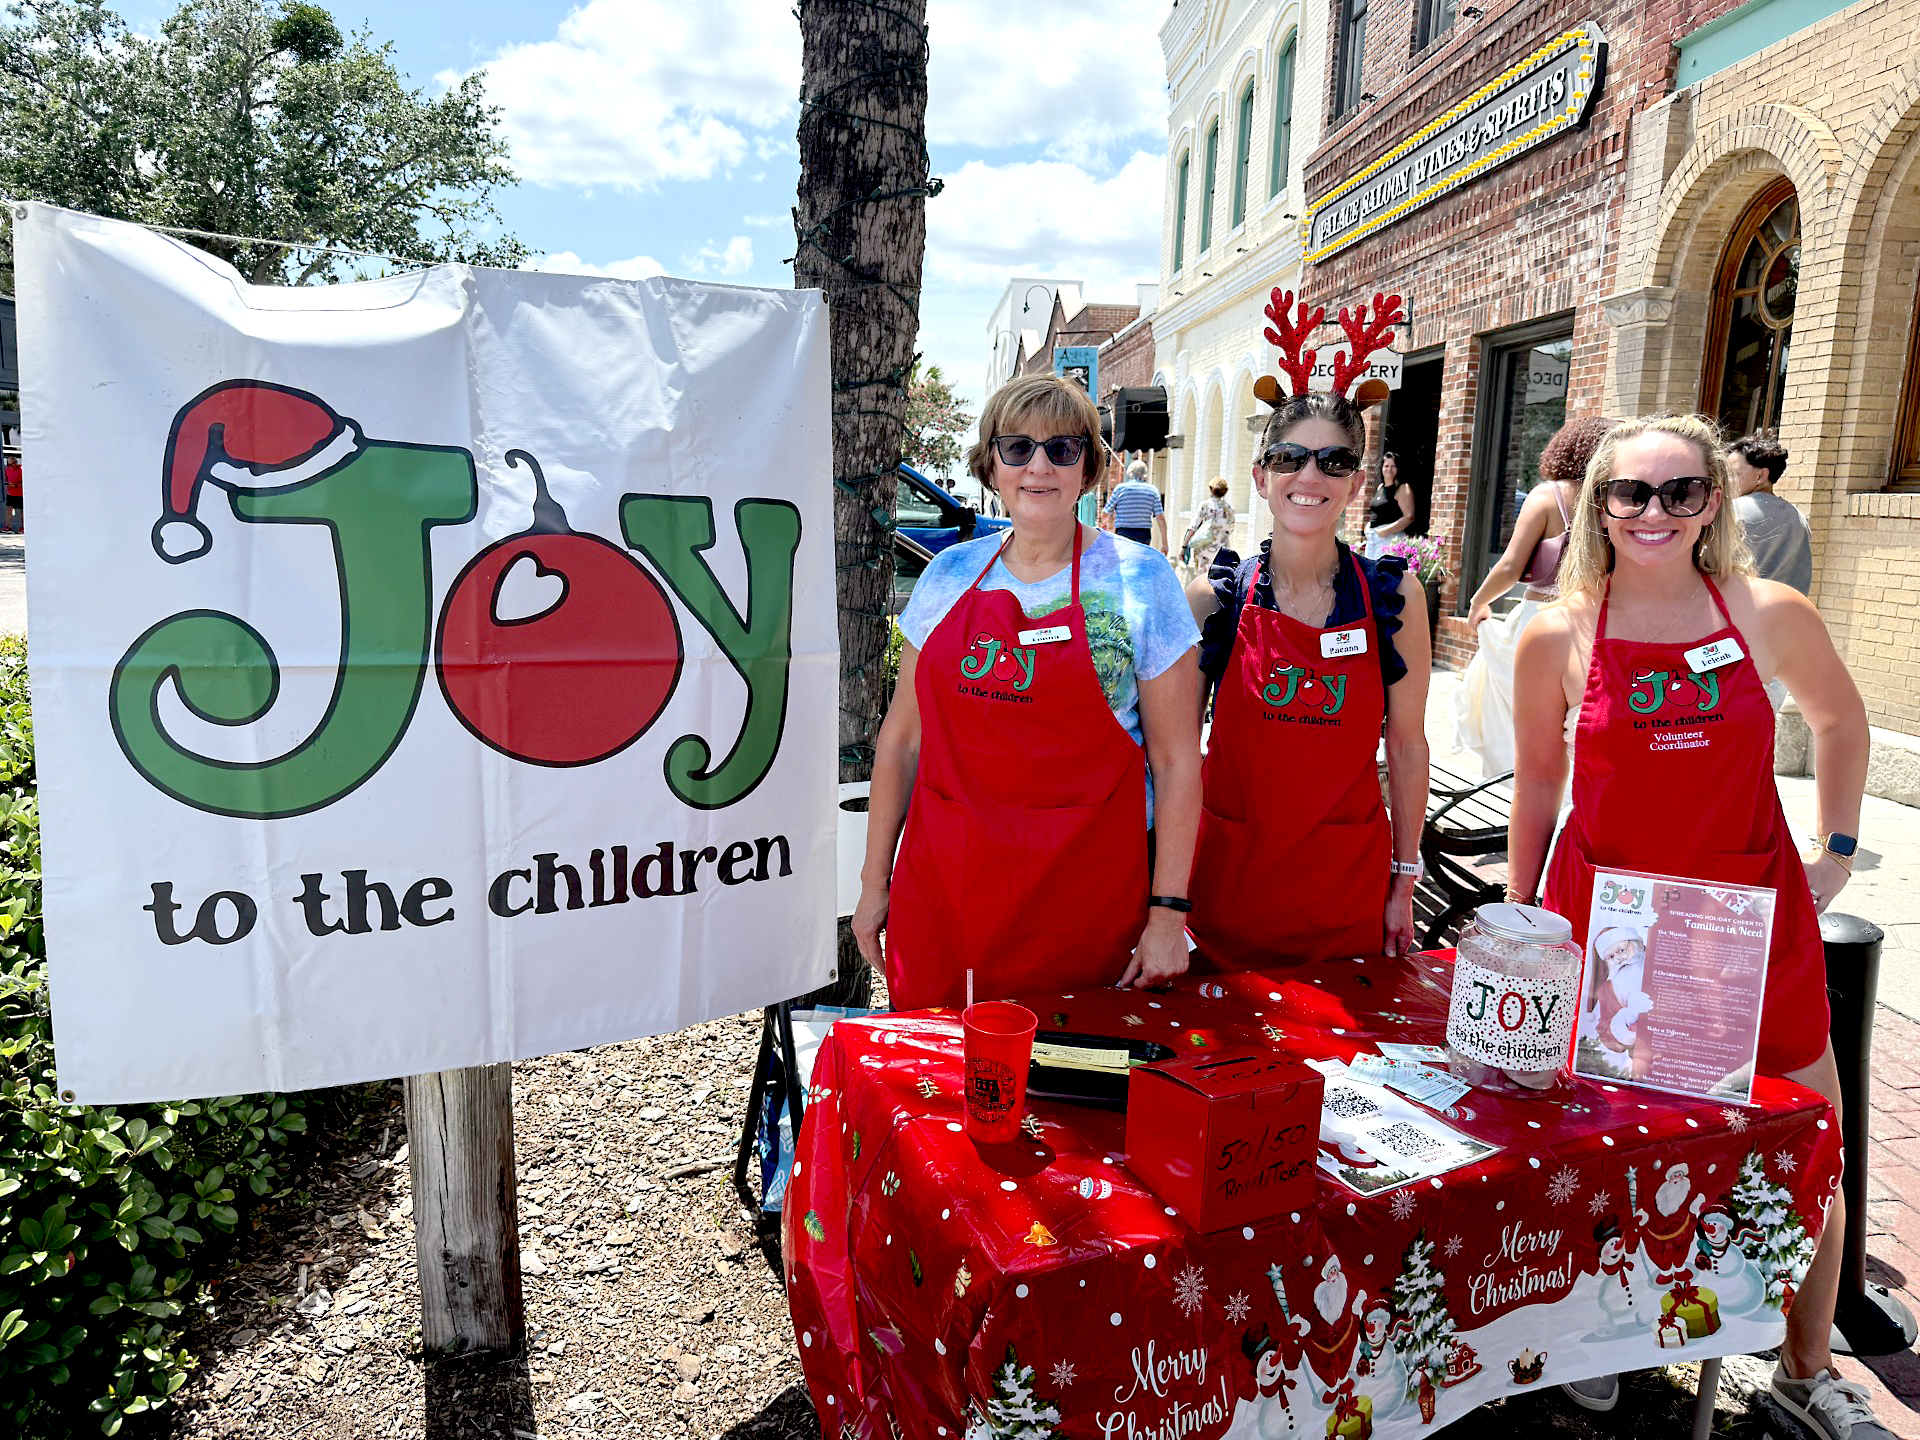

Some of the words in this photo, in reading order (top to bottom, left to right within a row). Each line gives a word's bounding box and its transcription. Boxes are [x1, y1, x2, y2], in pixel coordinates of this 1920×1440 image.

[1321, 198, 1360, 243] PALACE
[1362, 166, 1411, 218] SALOON
[1414, 129, 1467, 186] WINES
[1466, 123, 1486, 153] &
[1483, 67, 1567, 144] SPIRITS
[1309, 364, 1398, 378] DECERY
[958, 684, 968, 694] to
[971, 687, 989, 698] the
[991, 690, 1034, 704] children
[1263, 711, 1274, 720] to
[1278, 713, 1296, 723] the
[1299, 716, 1341, 727] children
[1633, 720, 1647, 729] to
[1651, 718, 1672, 728] the
[1675, 713, 1725, 727] children
[1650, 738, 1710, 751] Coordinator
[1654, 731, 1704, 743] Volunteer
[143, 880, 258, 945] to
[293, 869, 455, 936] the
[488, 834, 794, 918] children
[1669, 910, 1704, 920] SPREADING
[1705, 915, 1732, 923] HOLIDAY
[1685, 919, 1725, 933] Families
[1727, 925, 1737, 935] in
[1739, 926, 1763, 938] Need
[1466, 980, 1560, 1034] JOY
[1455, 1024, 1467, 1041] to
[1469, 1031, 1495, 1053] the
[1497, 1040, 1561, 1060] children
[1666, 1028, 1690, 1037] Difference
[1216, 1123, 1306, 1171] 50/50
[1483, 1220, 1564, 1268] Merry
[1468, 1251, 1573, 1315] Christmas!
[1114, 1339, 1209, 1404] Merry
